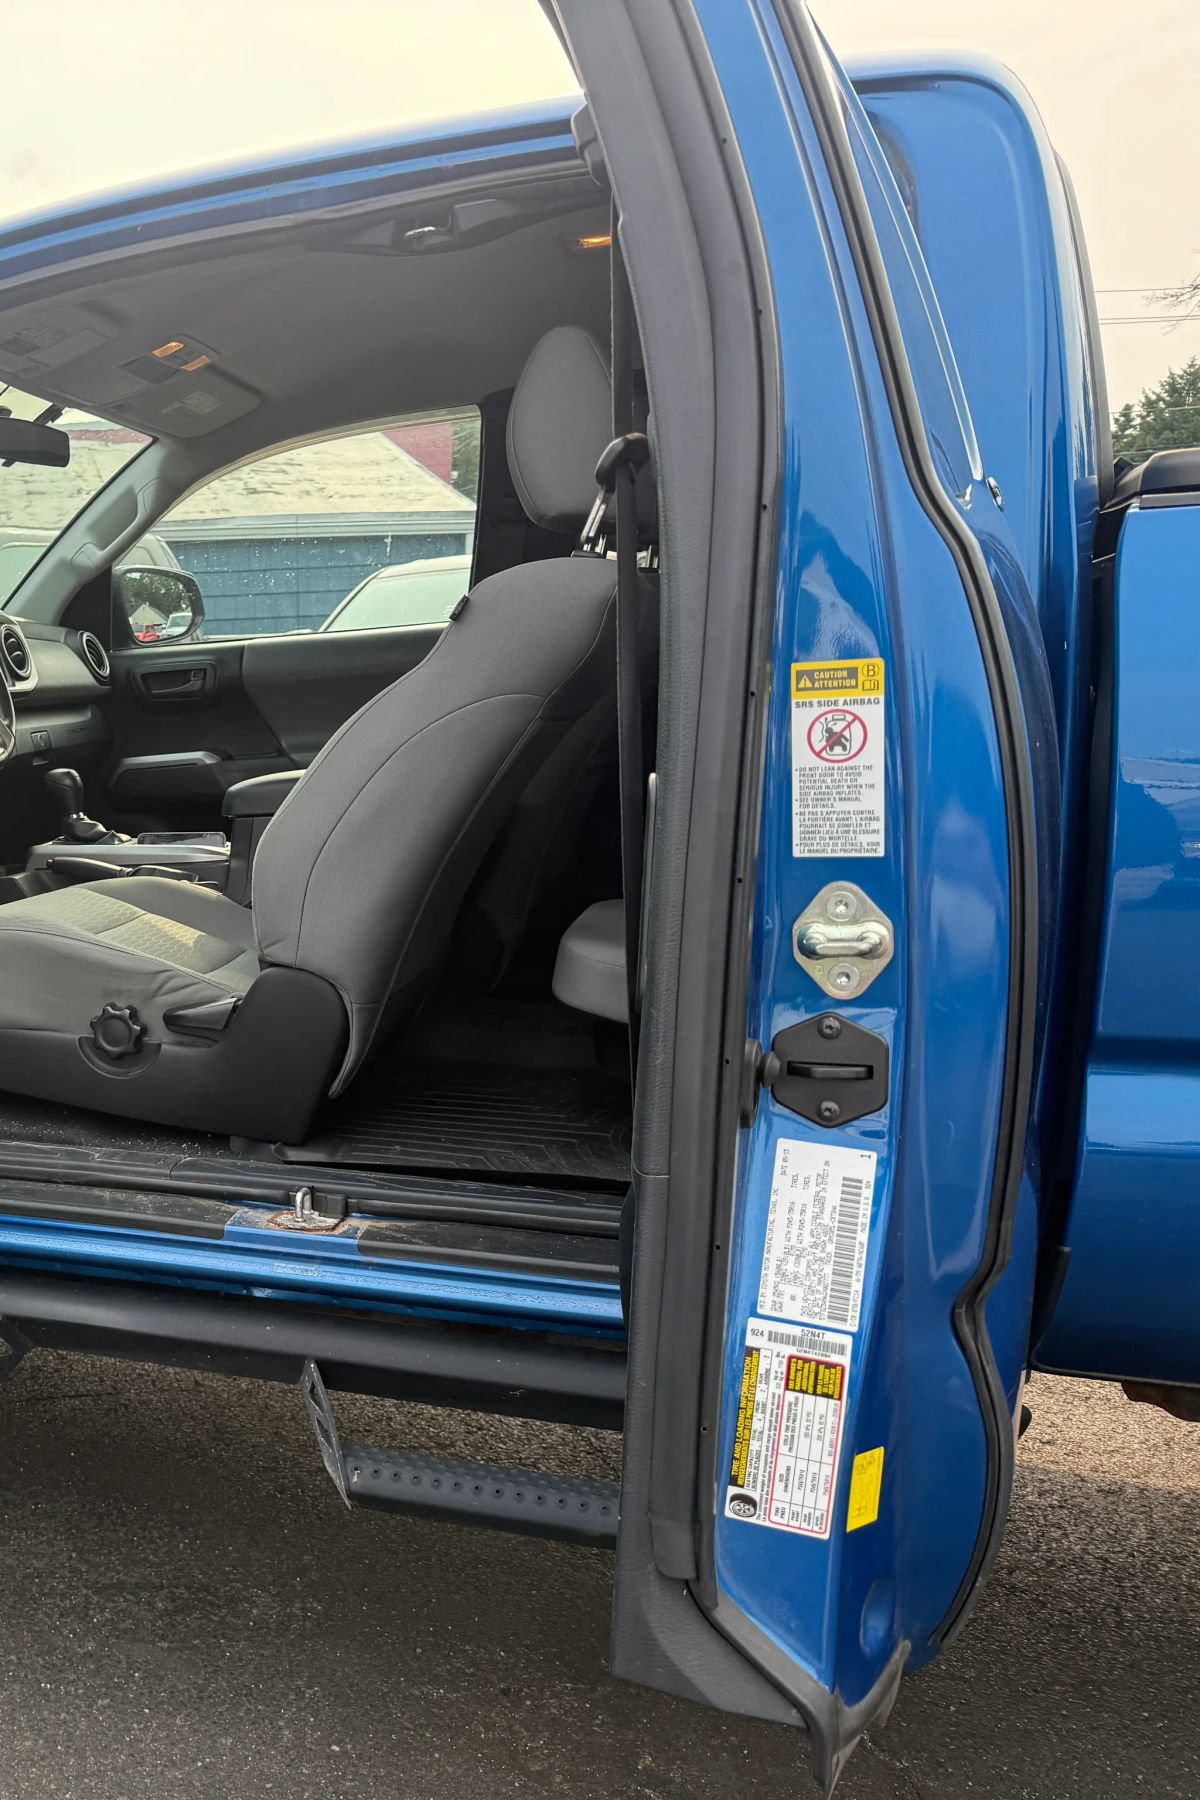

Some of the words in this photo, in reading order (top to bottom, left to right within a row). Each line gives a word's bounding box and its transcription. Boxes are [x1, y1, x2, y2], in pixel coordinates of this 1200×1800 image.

[814, 670, 847, 679] CAUTION
[867, 664, 876, 677] B
[814, 679, 856, 688] ATTENTION
[751, 1328, 764, 1337] 924
[801, 1329, 826, 1339] 52N4T
[740, 1357, 752, 1408] INFORMATION
[736, 1408, 746, 1441] LOADING
[738, 1440, 748, 1485] RENSEIGNEMENTS
